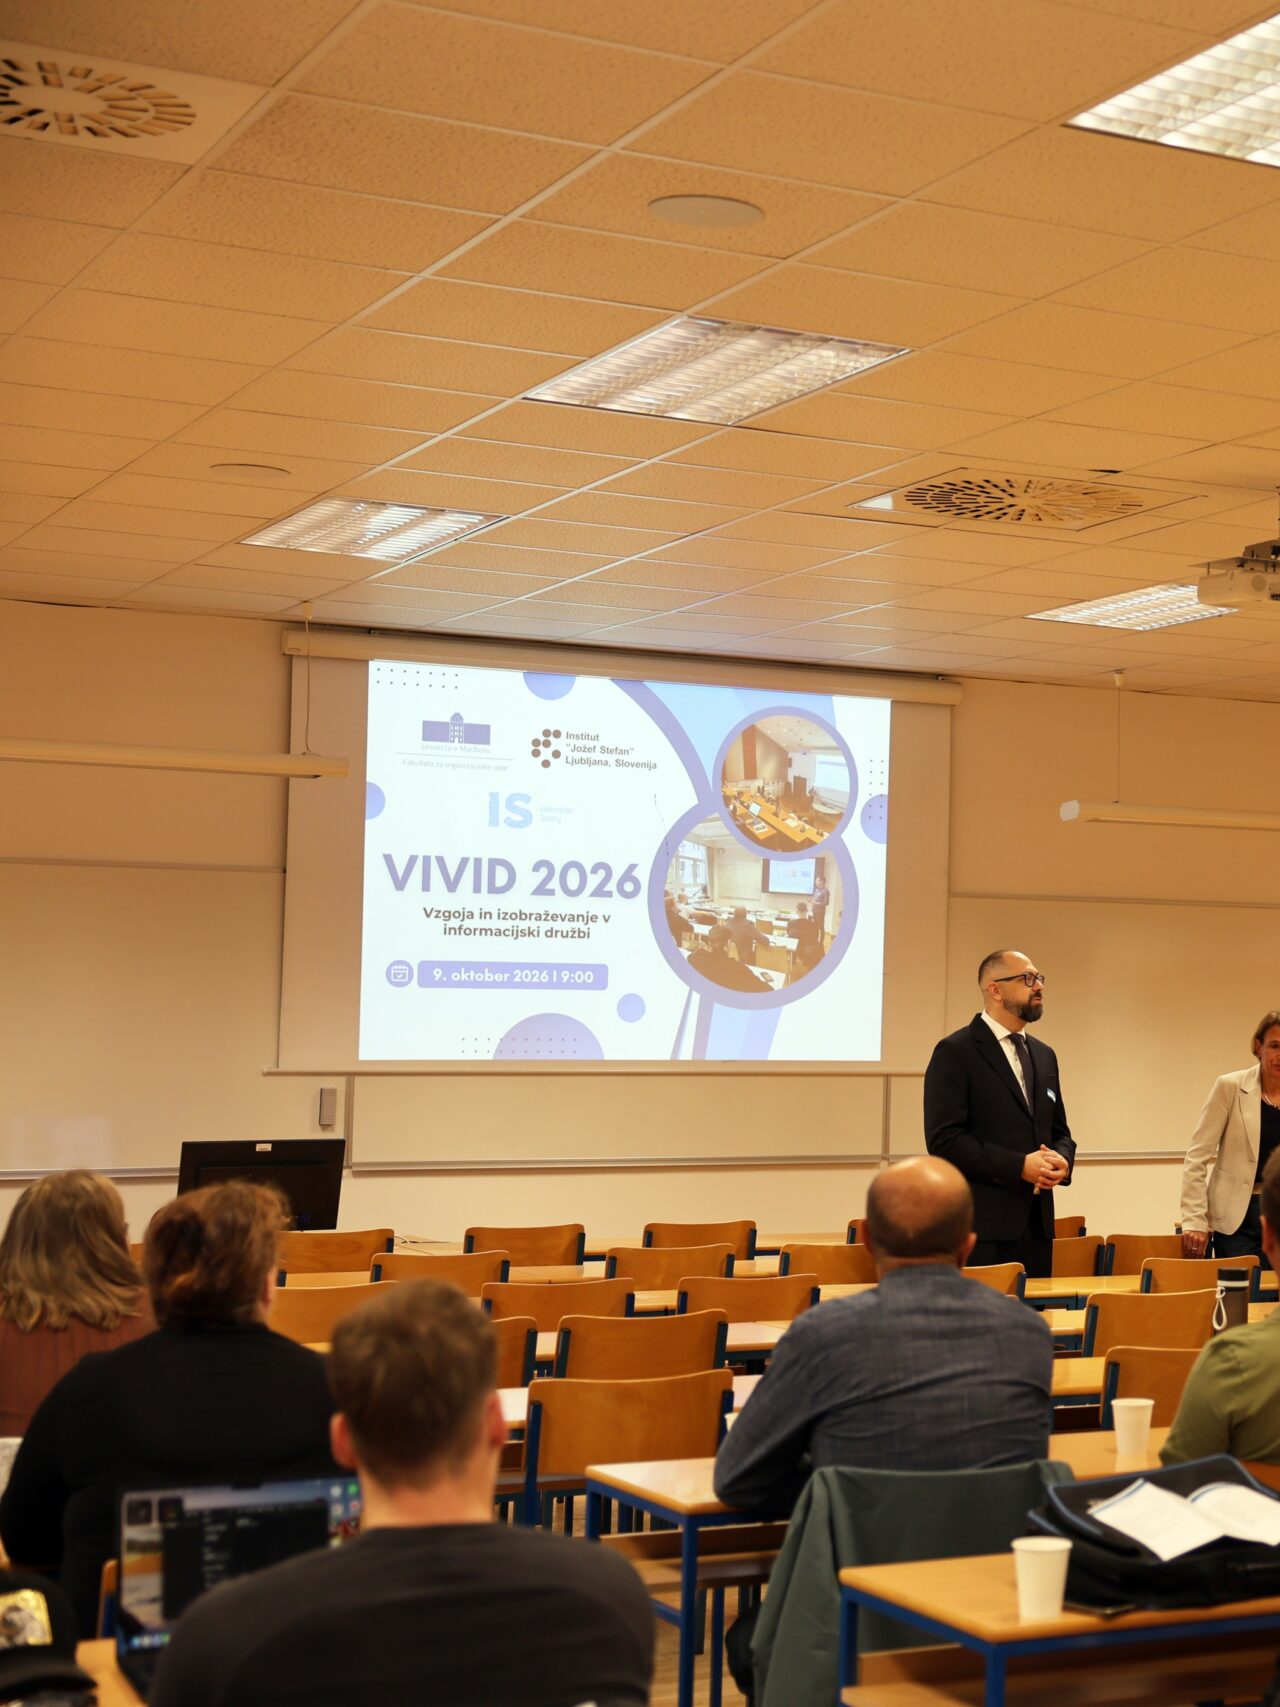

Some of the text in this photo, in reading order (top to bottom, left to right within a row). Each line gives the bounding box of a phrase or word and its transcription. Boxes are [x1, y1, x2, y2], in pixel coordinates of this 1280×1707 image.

[566, 731, 600, 741] Institut
[565, 756, 657, 771] Ljubljana, Slovenija
[488, 792, 533, 829] IS
[382, 853, 642, 899] VIVID 2026
[423, 907, 611, 925] Vzgoja in izobraževanje v
[443, 924, 591, 940] informacijski družbi
[433, 968, 447, 981] 9.
[451, 968, 510, 982] oktober
[513, 969, 549, 983] 2026
[561, 970, 594, 983] 9:00
